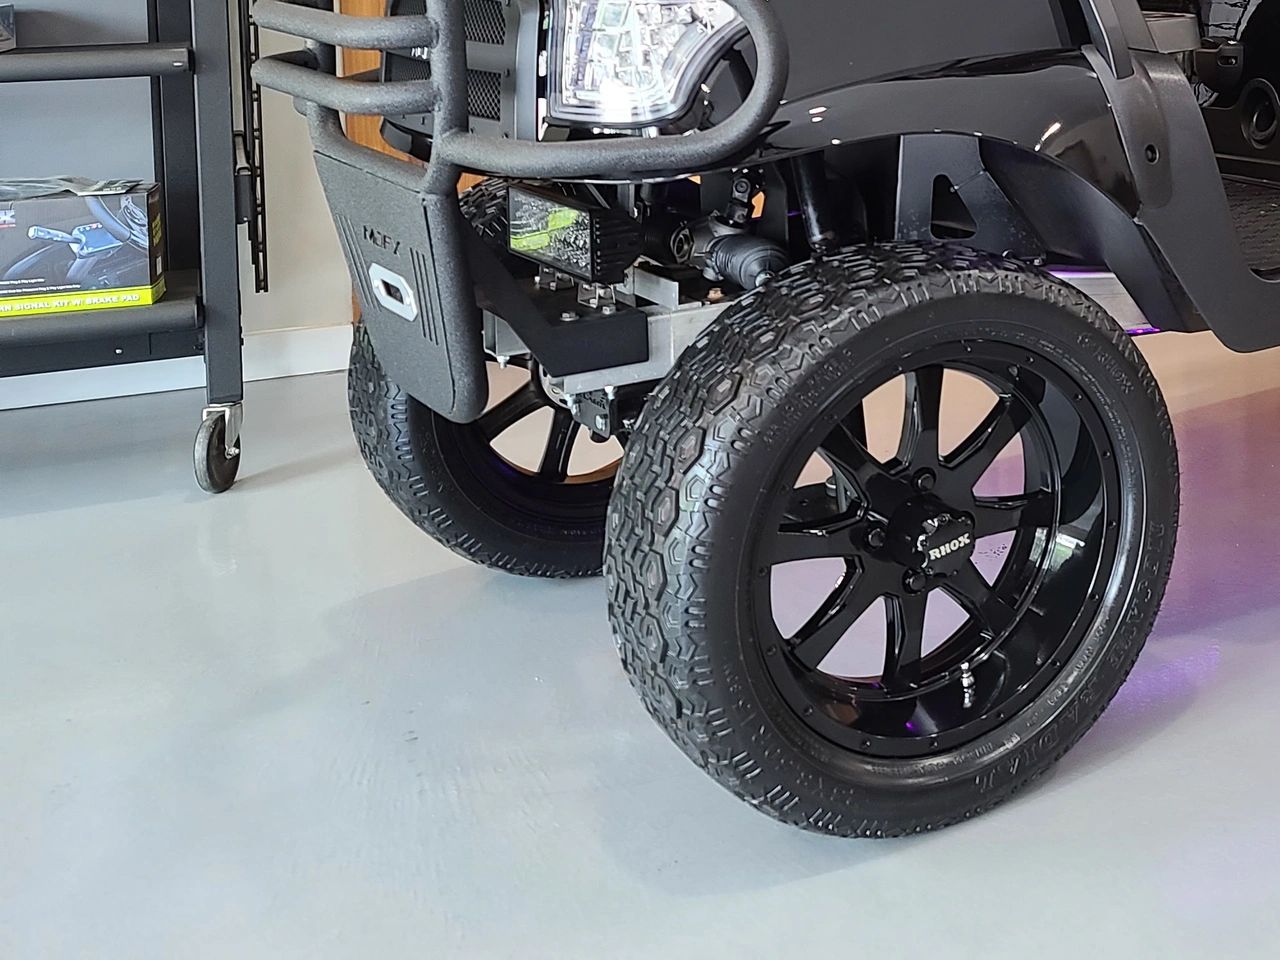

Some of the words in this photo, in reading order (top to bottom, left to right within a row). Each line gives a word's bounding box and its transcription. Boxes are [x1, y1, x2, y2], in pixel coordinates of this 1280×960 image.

[85, 295, 118, 305] BRAKE
[121, 294, 140, 302] PAD
[929, 533, 971, 560] RHOX
